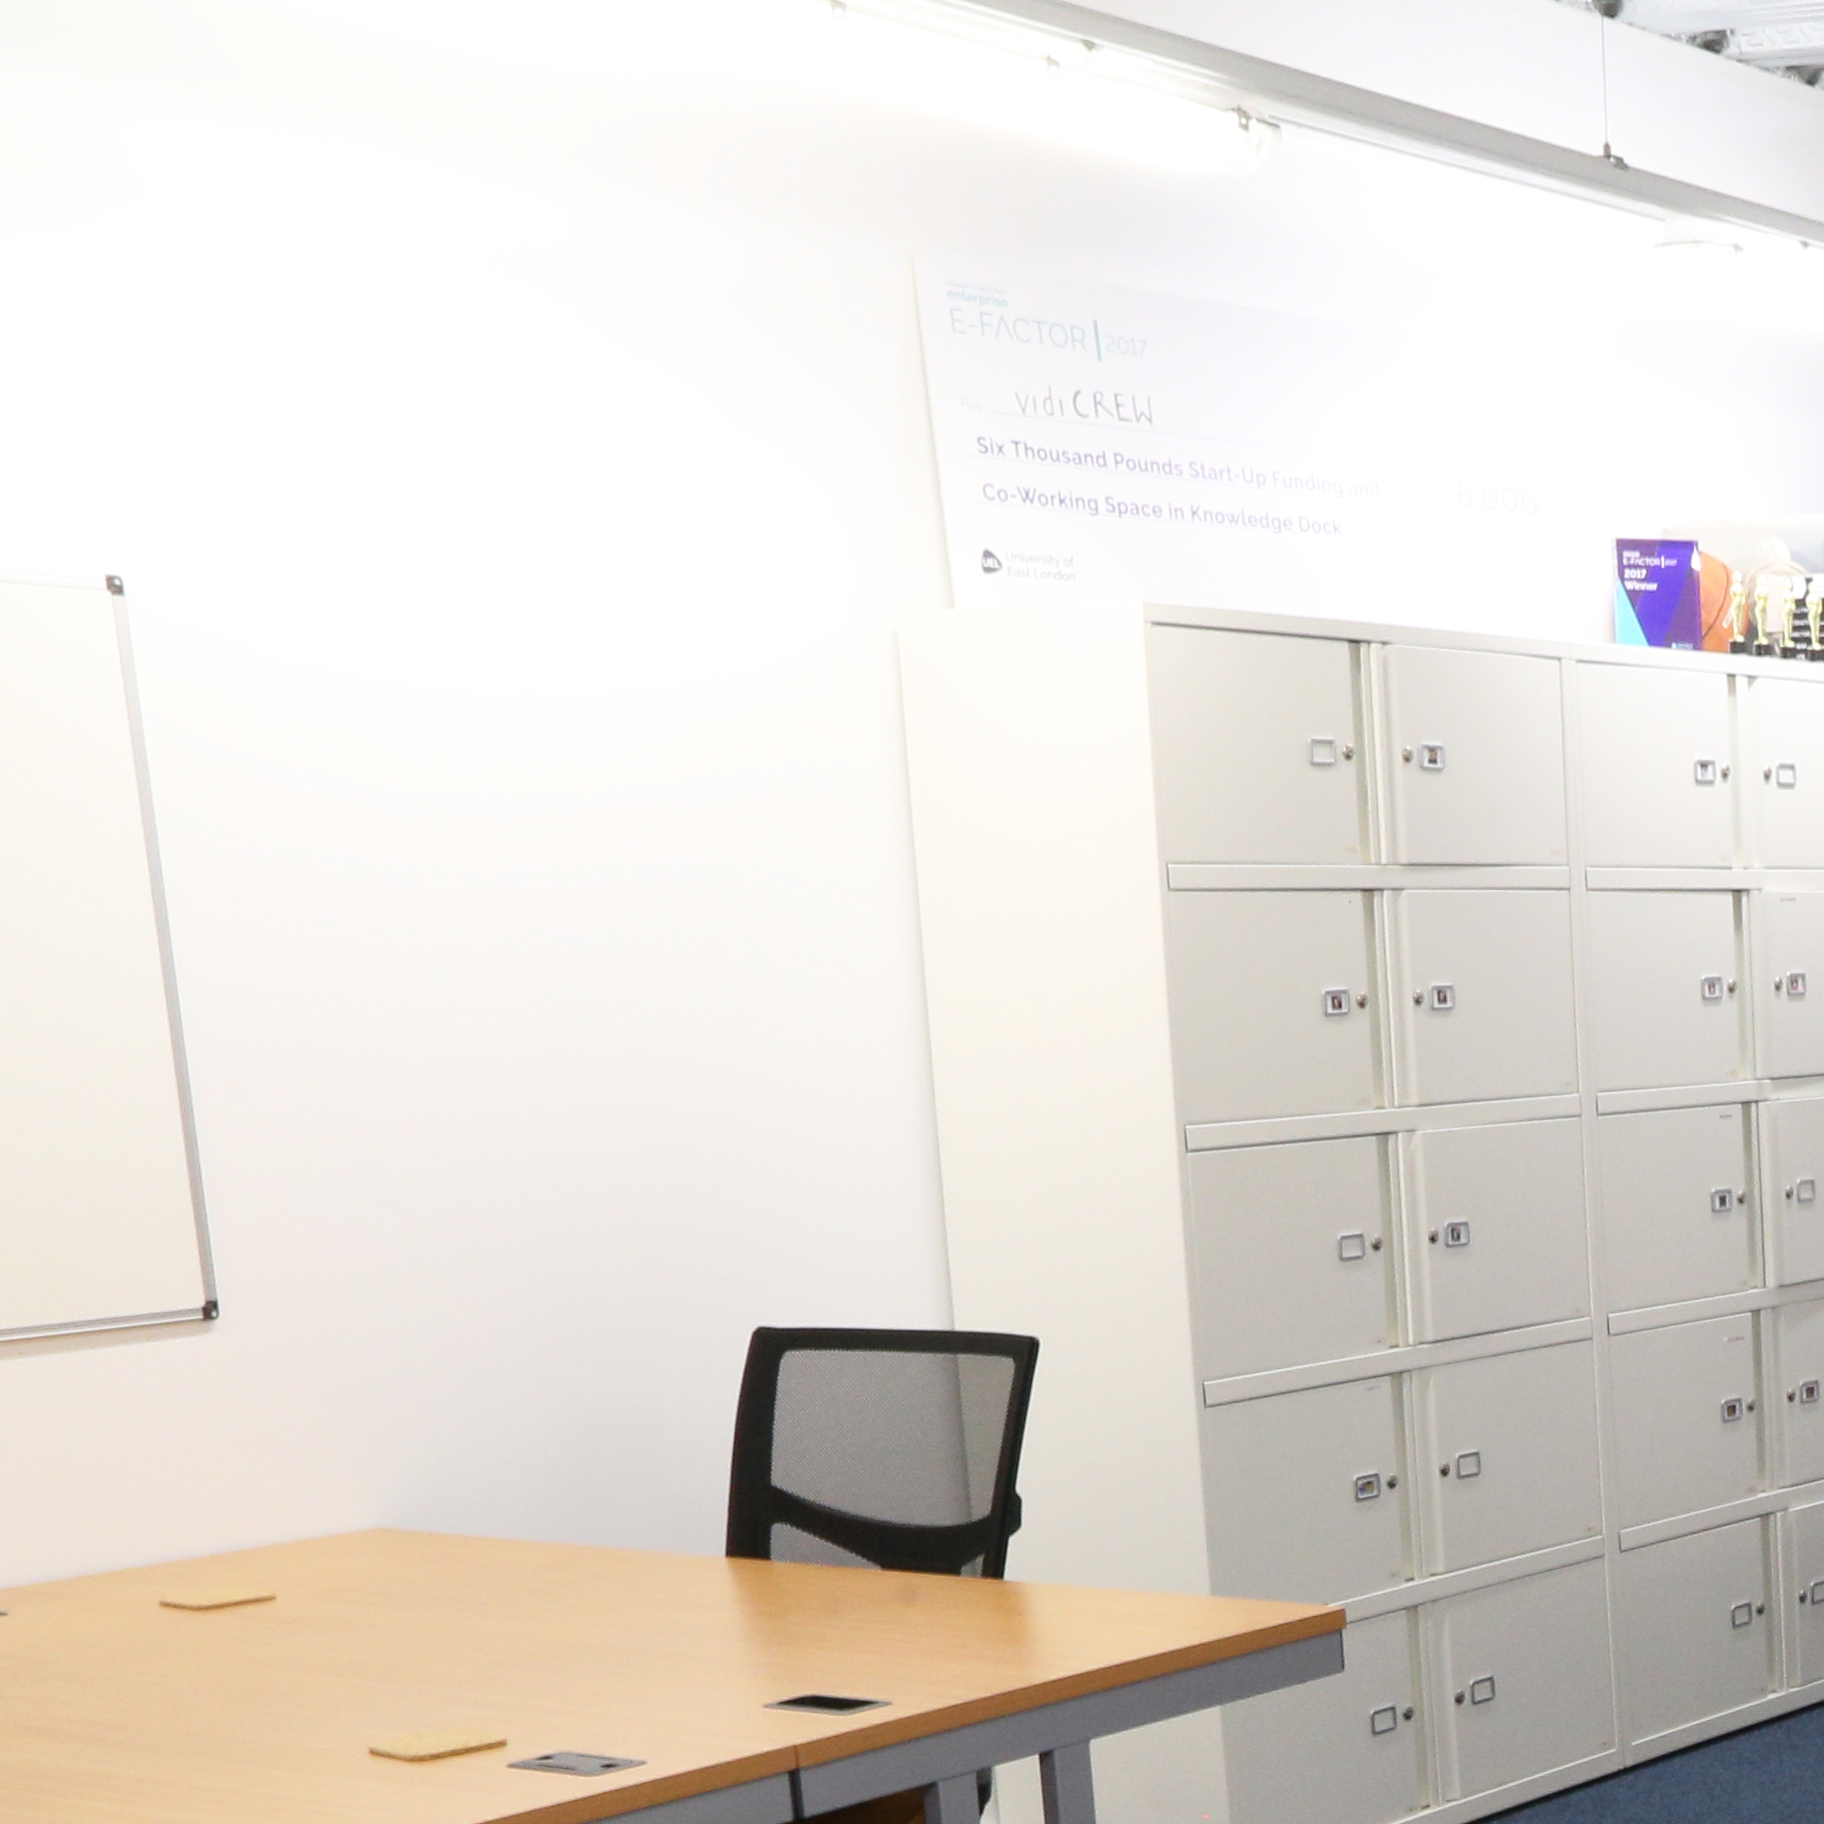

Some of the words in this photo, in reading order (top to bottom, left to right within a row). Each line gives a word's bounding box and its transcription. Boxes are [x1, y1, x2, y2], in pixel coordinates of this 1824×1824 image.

[1106, 335, 1149, 357] 2017
[976, 437, 1006, 457] Six
[1011, 440, 1108, 468] Thousand
[1113, 452, 1184, 478] Pounds
[1188, 461, 1267, 490] Start-Up
[1272, 470, 1344, 498] Funding
[1349, 482, 1381, 498] and
[982, 483, 1100, 516] Co-Working
[1104, 496, 1163, 519] Space
[1167, 502, 1185, 521] in
[1190, 504, 1293, 534] Knowledge
[1298, 515, 1343, 536] Dock
[1005, 550, 1060, 568] University
[1063, 556, 1074, 567] of
[1007, 565, 1032, 578] East
[1034, 567, 1076, 581] London
[1624, 569, 1648, 579] 2017
[1624, 580, 1659, 591] Winner
